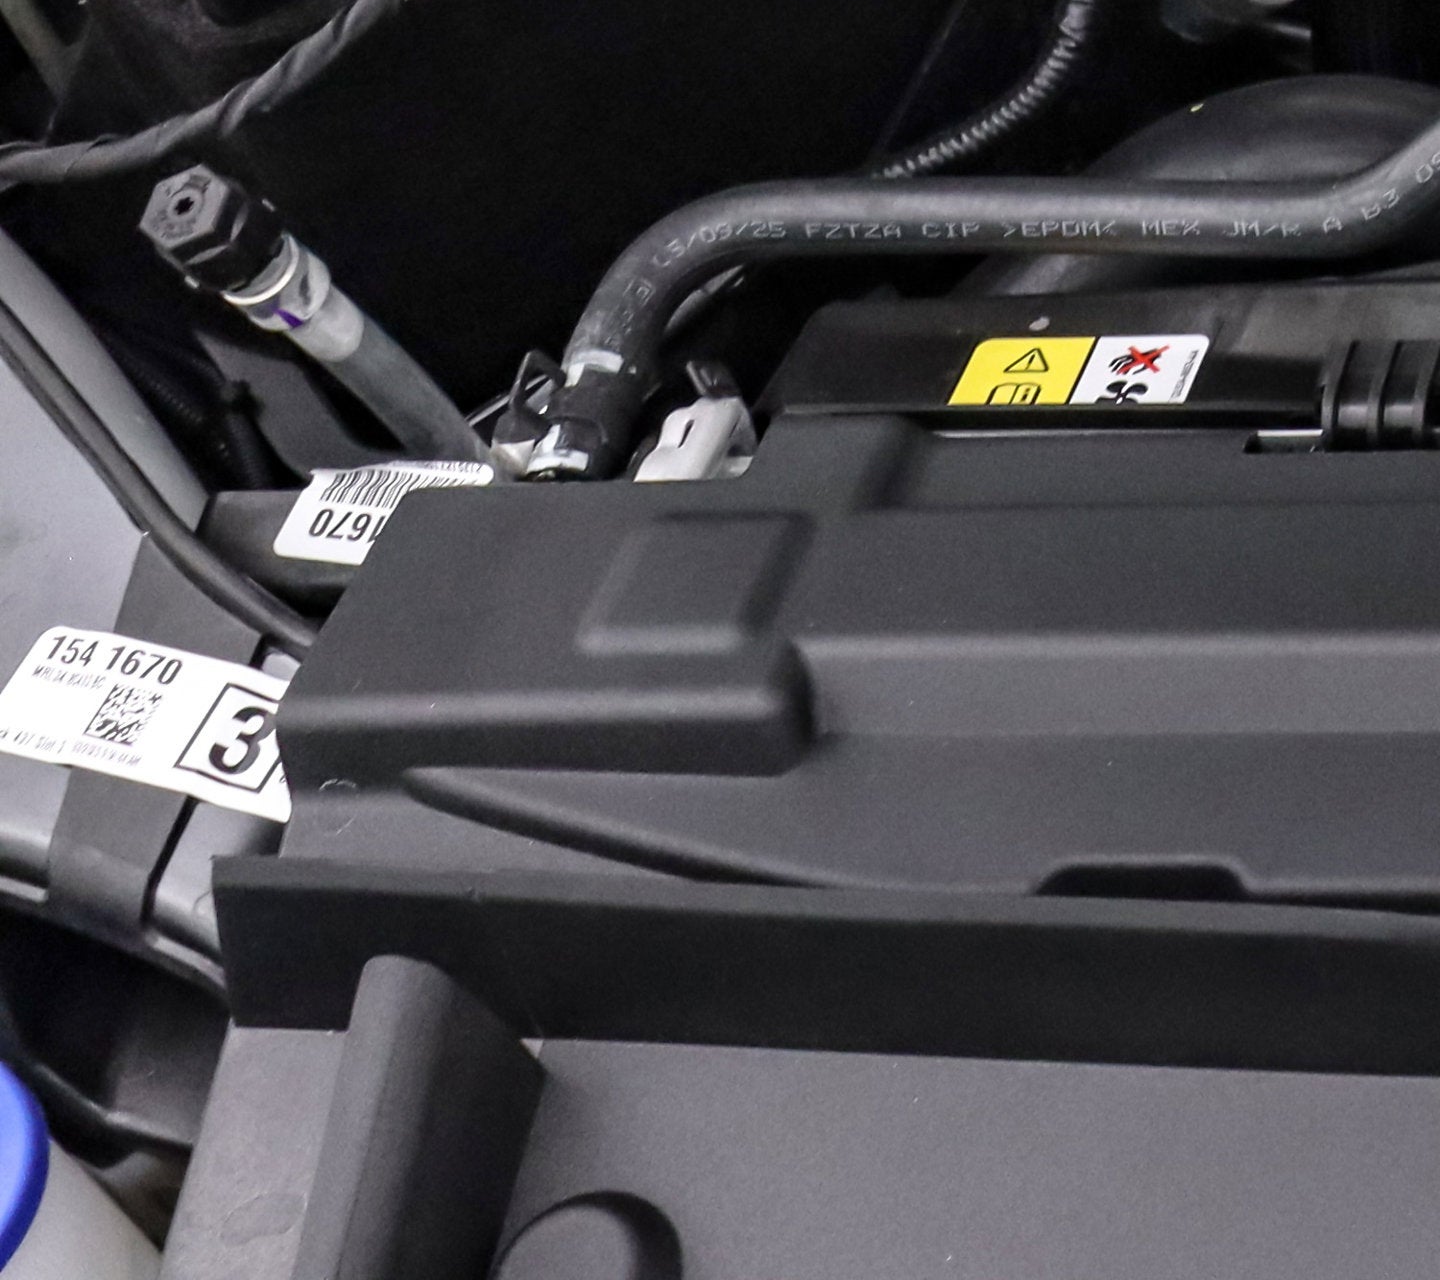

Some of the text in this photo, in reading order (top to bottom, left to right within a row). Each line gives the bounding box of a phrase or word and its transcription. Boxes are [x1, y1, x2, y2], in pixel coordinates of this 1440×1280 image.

[47, 635, 100, 667] 154
[105, 645, 184, 685] 1670
[208, 705, 278, 775] 3
